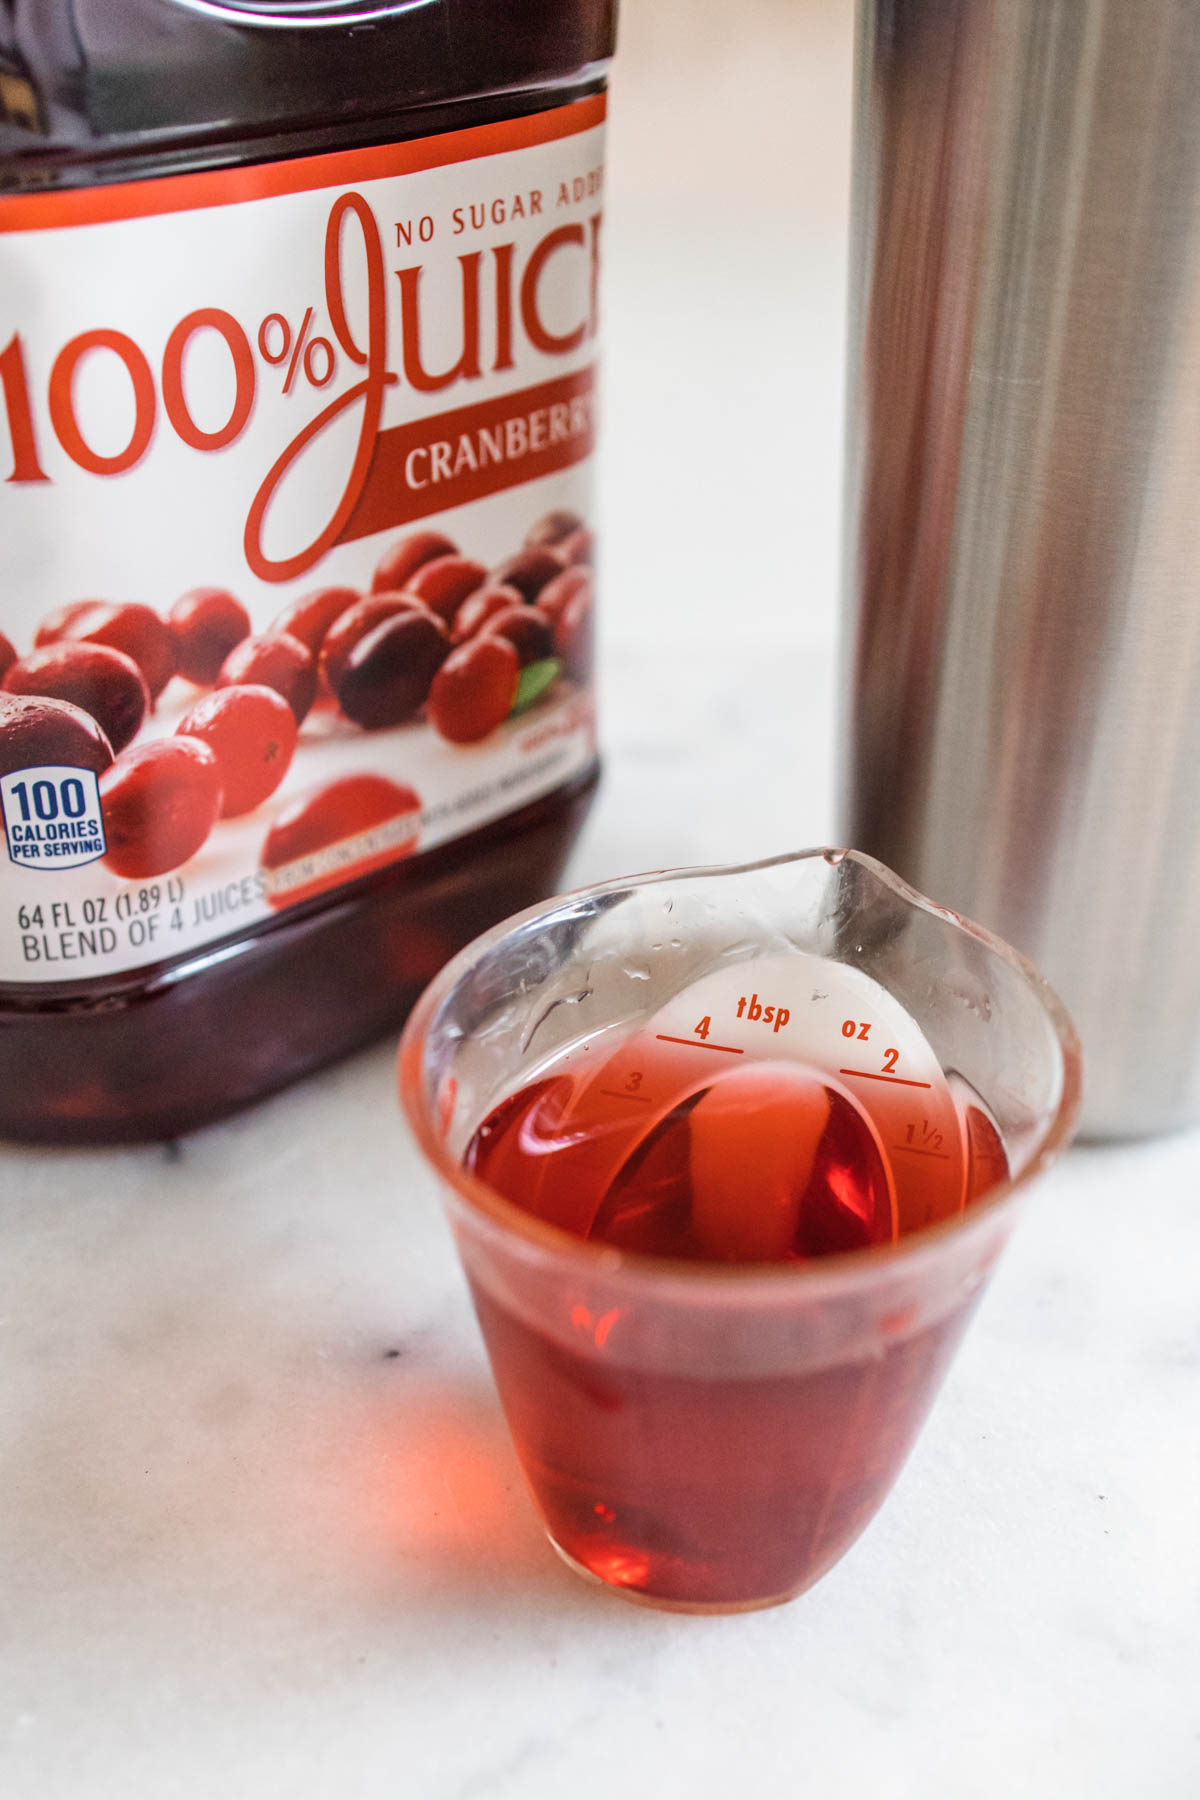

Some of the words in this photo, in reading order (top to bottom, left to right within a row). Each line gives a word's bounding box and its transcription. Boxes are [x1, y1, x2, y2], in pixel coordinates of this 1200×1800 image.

[395, 216, 434, 248] NO
[452, 189, 543, 234] SUGAR
[557, 165, 603, 208] ADD
[0, 307, 335, 482] 100%
[11, 778, 86, 821] 100
[12, 819, 99, 842] CALORIES
[13, 844, 40, 858] PER
[44, 838, 102, 857] SERVING
[18, 904, 44, 930] 64
[51, 902, 76, 928] FL
[82, 897, 108, 925] OZ
[115, 884, 161, 921] (1.89
[167, 877, 184, 903] L)
[22, 927, 117, 962] BLEND
[129, 914, 160, 947] OF
[170, 906, 183, 931] 4
[193, 870, 266, 927] JUICES
[694, 1015, 711, 1040] 4
[736, 993, 790, 1033] tbsp
[841, 1019, 872, 1041] oz
[881, 1048, 899, 1074] 2
[625, 1071, 643, 1092] 3
